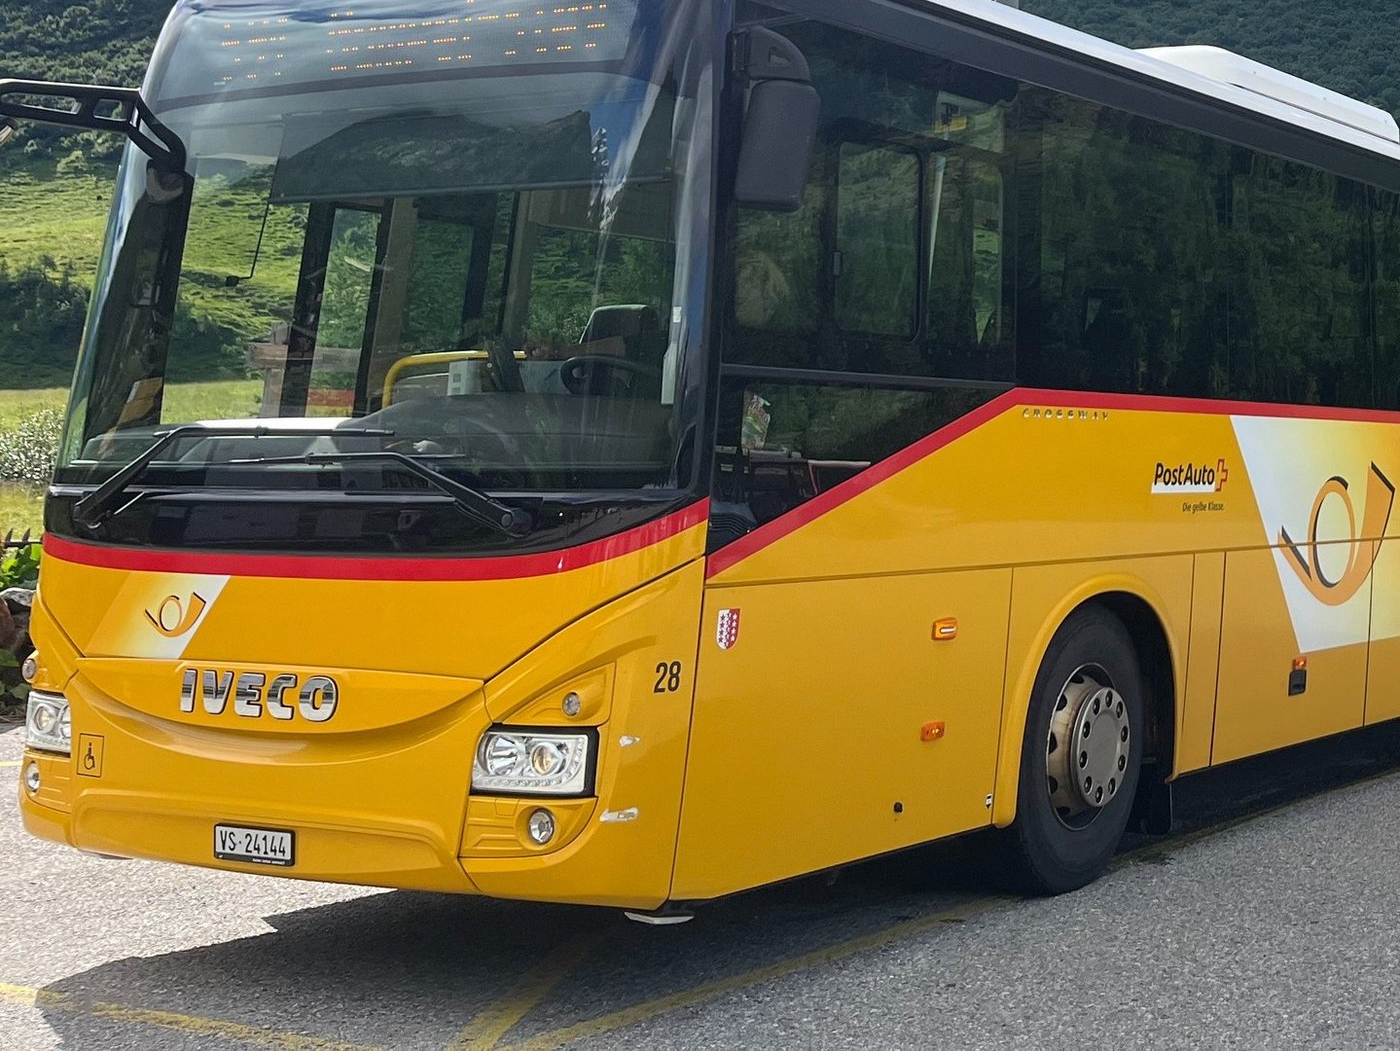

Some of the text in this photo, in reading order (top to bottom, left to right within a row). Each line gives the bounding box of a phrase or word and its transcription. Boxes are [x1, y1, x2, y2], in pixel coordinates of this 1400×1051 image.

[1022, 408, 1109, 421] CROSSWAY
[1154, 462, 1215, 486] PostAuto
[653, 660, 682, 693] 28
[179, 668, 339, 722] IVECO
